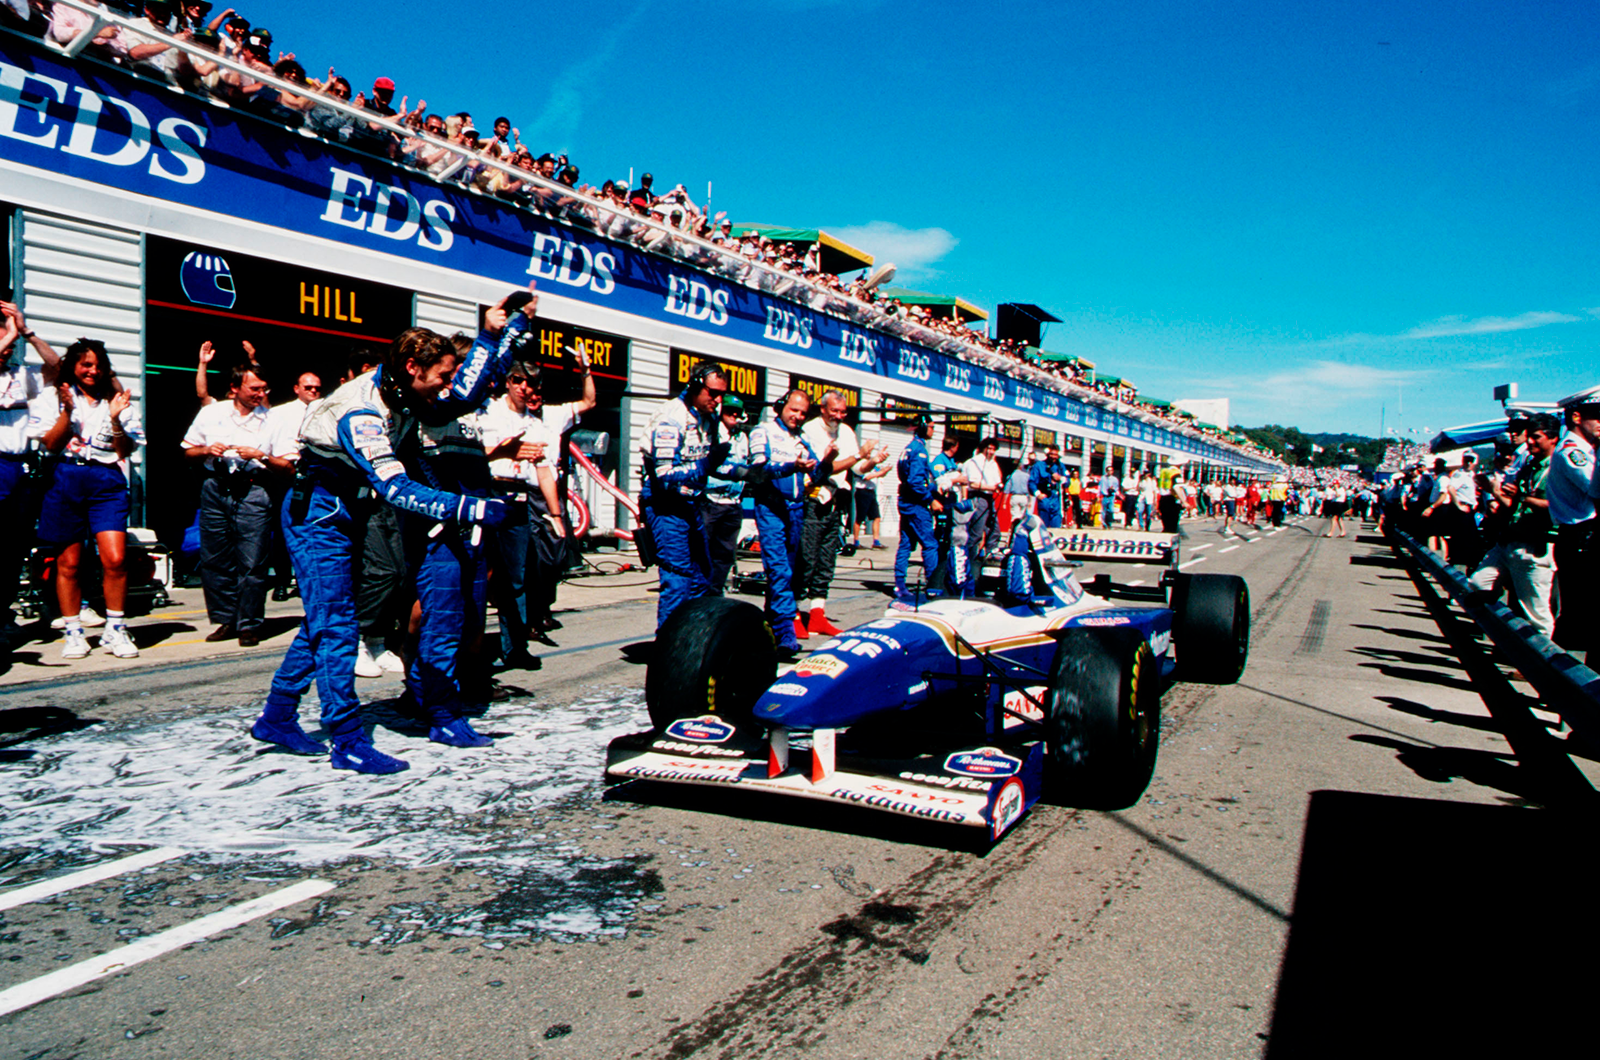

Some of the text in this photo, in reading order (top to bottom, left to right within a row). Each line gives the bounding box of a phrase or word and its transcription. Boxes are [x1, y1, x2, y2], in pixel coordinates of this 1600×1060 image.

[0, 62, 207, 185] EDS
[320, 167, 456, 252] EDS
[526, 231, 616, 295] EDS
[300, 281, 363, 324] HILL
[664, 274, 729, 326] EDS
[763, 306, 813, 349] EDS
[839, 330, 878, 366] EDS
[897, 348, 930, 381] EDS
[454, 346, 489, 397] Labatt
[944, 363, 971, 392] EDS
[983, 375, 1005, 401] EDS
[1015, 385, 1034, 409] EDS
[1041, 394, 1059, 416] EDS
[386, 485, 446, 520] Labatt
[1050, 532, 1170, 557] othmans
[652, 740, 745, 757] GOODYEAR
[956, 755, 1012, 769] Rothmans
[626, 766, 742, 784] Rothmans
[829, 788, 968, 823] Rothmans
[864, 784, 965, 805] SANYO
